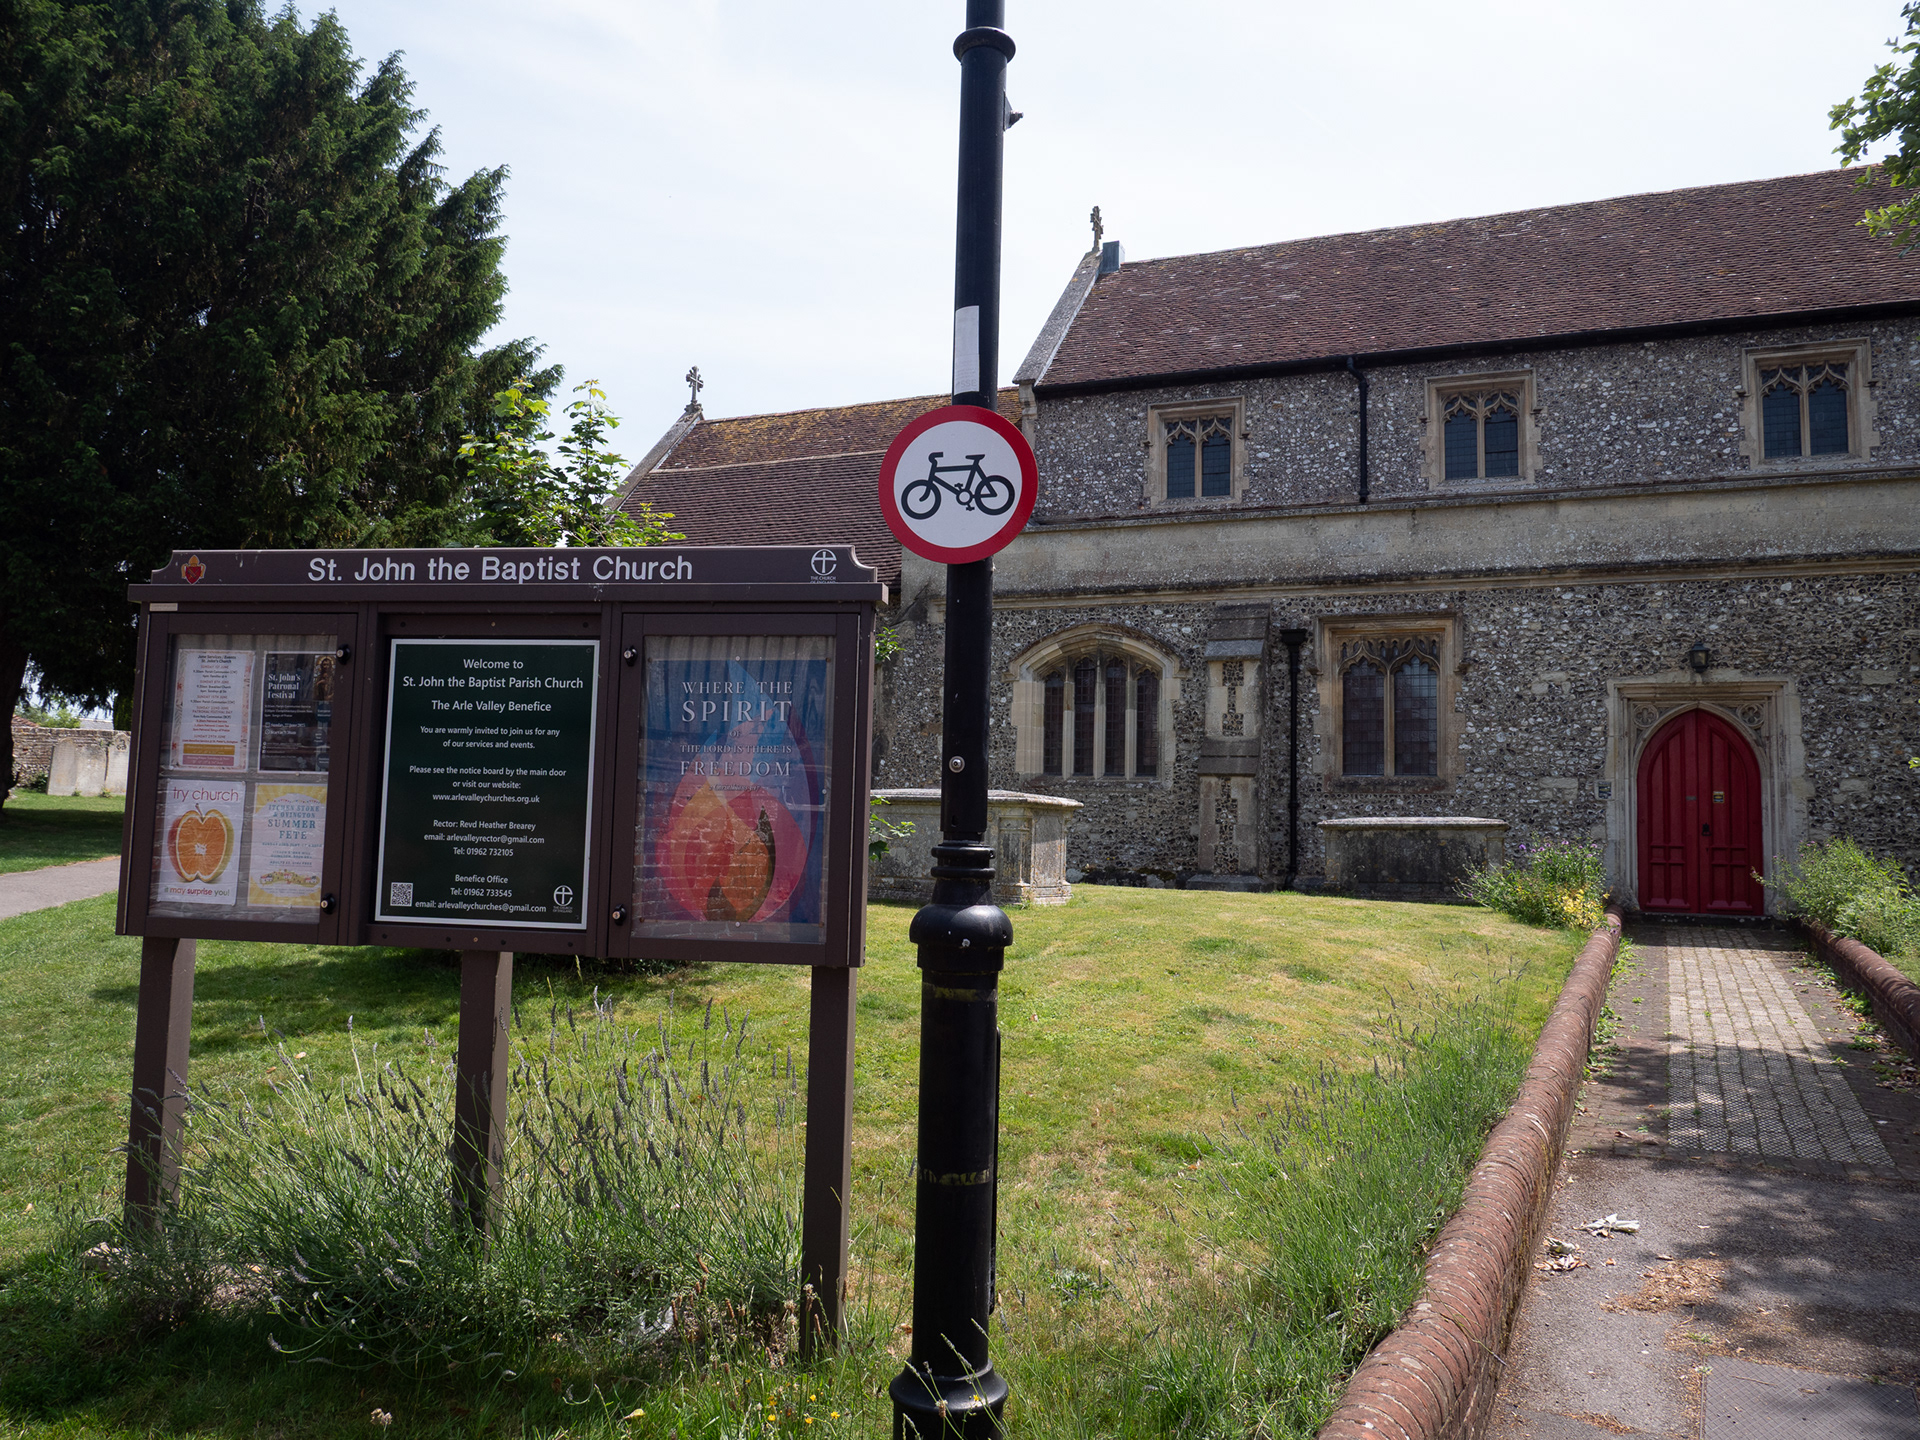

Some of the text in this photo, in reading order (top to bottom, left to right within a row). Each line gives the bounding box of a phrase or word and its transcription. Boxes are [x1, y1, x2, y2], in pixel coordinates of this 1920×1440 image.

[308, 556, 692, 584] St. John the Baptist Church
[463, 659, 524, 669] Welcome to
[279, 674, 301, 683] John's
[403, 676, 583, 690] St. John the Baptist Parish Church
[682, 681, 792, 694] WHERE THE
[432, 700, 551, 713] The Arle Valley Benefice
[682, 700, 792, 722] SPIRIT
[448, 726, 473, 736] warmly
[509, 727, 523, 736] join
[547, 729, 560, 737] any
[680, 745, 700, 753] THE
[704, 745, 731, 753] LORD
[733, 745, 742, 753] IS
[409, 765, 431, 774] Please
[483, 767, 504, 775] board
[506, 767, 514, 777] by
[549, 768, 566, 776] door
[680, 761, 790, 776] FREEDOM
[492, 781, 521, 789] website:
[173, 787, 238, 802] try church
[433, 793, 540, 804] www.arlevalleychurches.org.uk
[268, 819, 316, 828] SUMMER
[509, 822, 536, 831] Brearey
[280, 830, 307, 839] FETE
[446, 833, 544, 844] arlevalleyrector@gmail.com
[455, 875, 508, 884] Benefice Office
[450, 888, 512, 898] Tel: 01962 733545
[438, 901, 546, 913] arlevalleychurches@gmail.com
